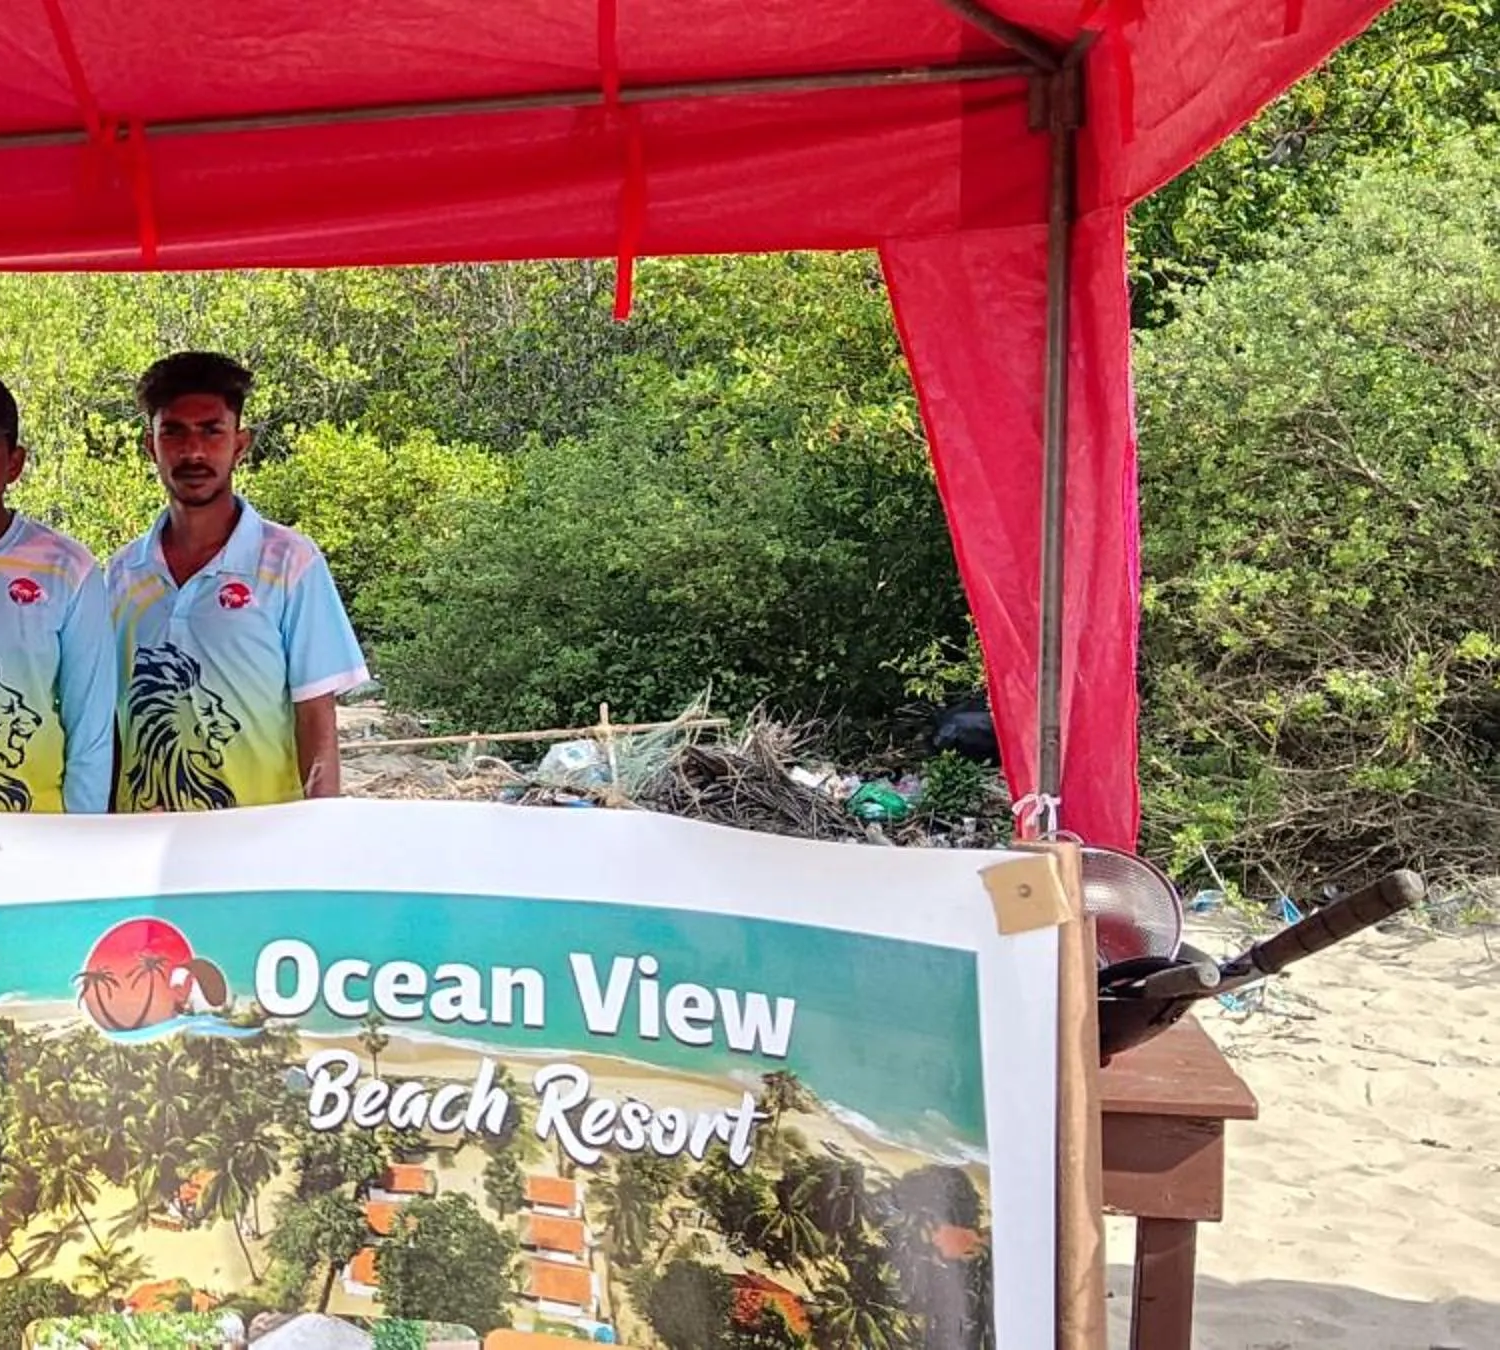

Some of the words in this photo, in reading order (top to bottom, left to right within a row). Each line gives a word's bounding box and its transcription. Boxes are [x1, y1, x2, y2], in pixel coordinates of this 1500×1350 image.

[255, 939, 545, 1027] Ocean
[569, 952, 796, 1057] View
[306, 1048, 510, 1134] Beach
[532, 1063, 770, 1167] Resort
